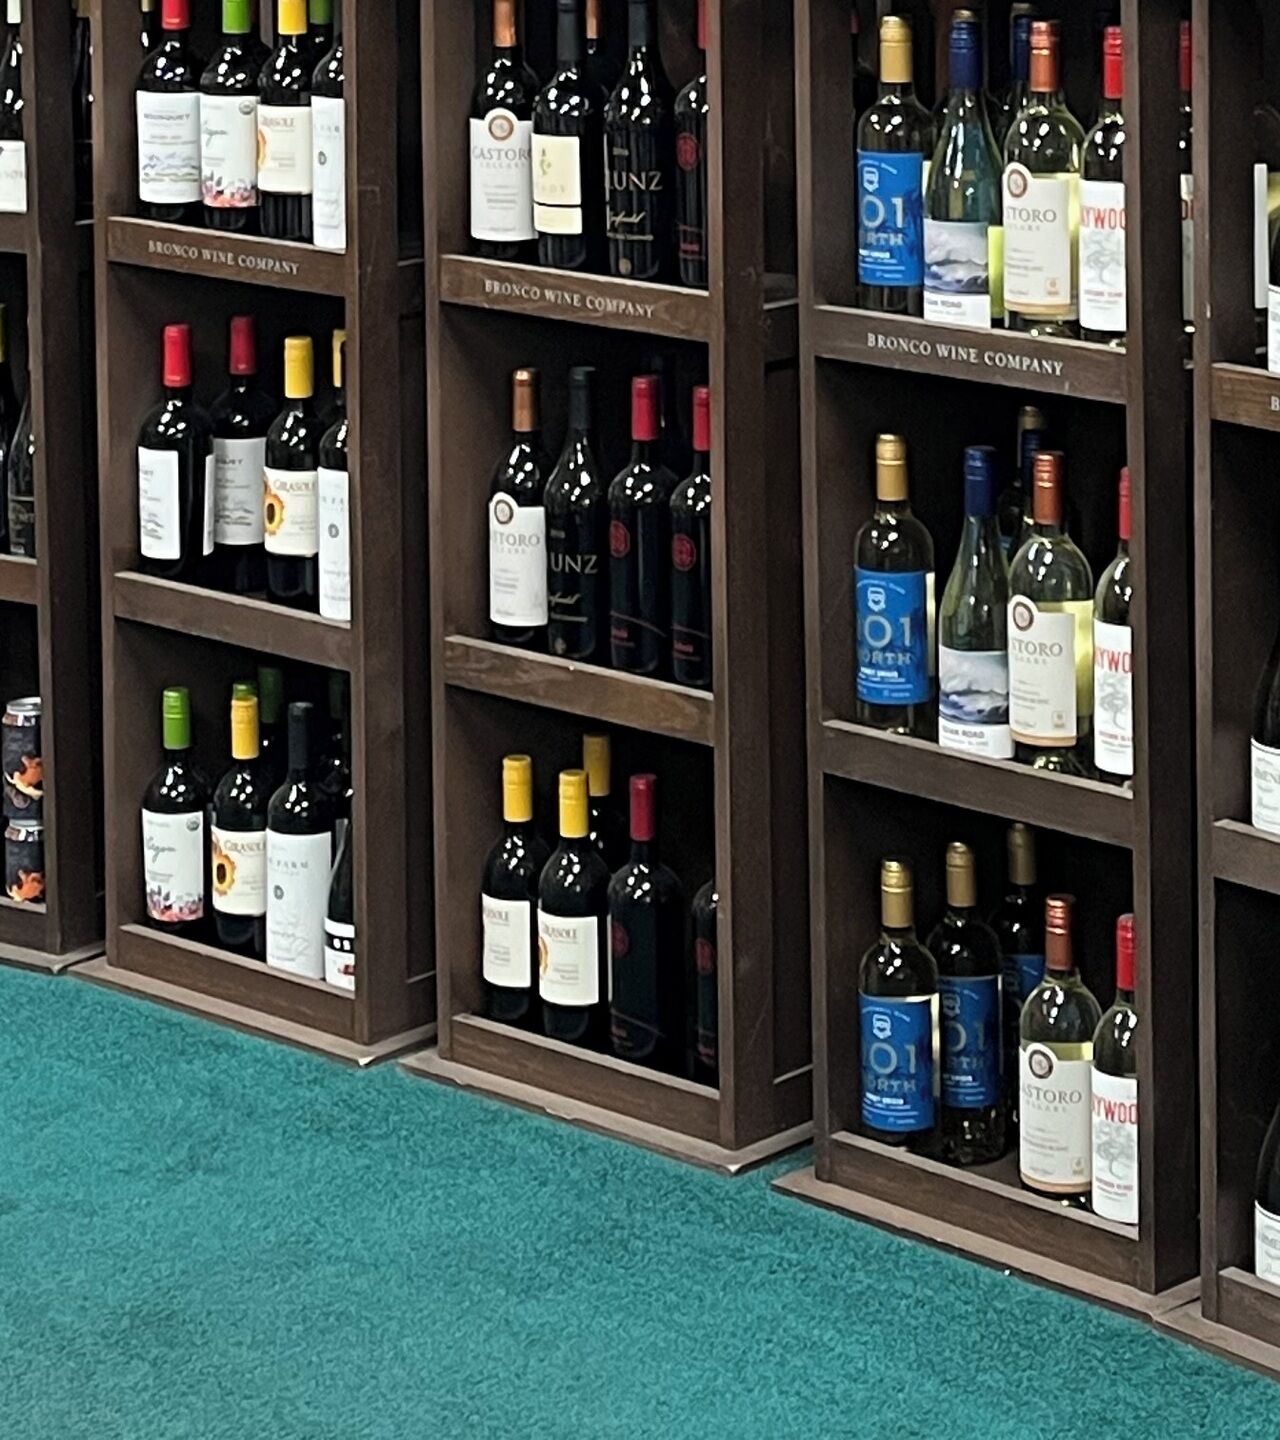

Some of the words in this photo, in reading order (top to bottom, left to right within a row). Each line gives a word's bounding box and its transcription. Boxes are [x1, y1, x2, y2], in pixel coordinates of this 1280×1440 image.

[148, 239, 199, 259] BRONCO
[201, 248, 235, 265] WINE
[237, 253, 299, 276] COMPANY
[484, 279, 541, 301] BRONCO
[544, 288, 581, 307] WINE
[585, 295, 656, 319] COMPANY
[866, 332, 932, 356] BRONCO
[935, 342, 979, 363] WINE
[983, 350, 1064, 377] COMPANY
